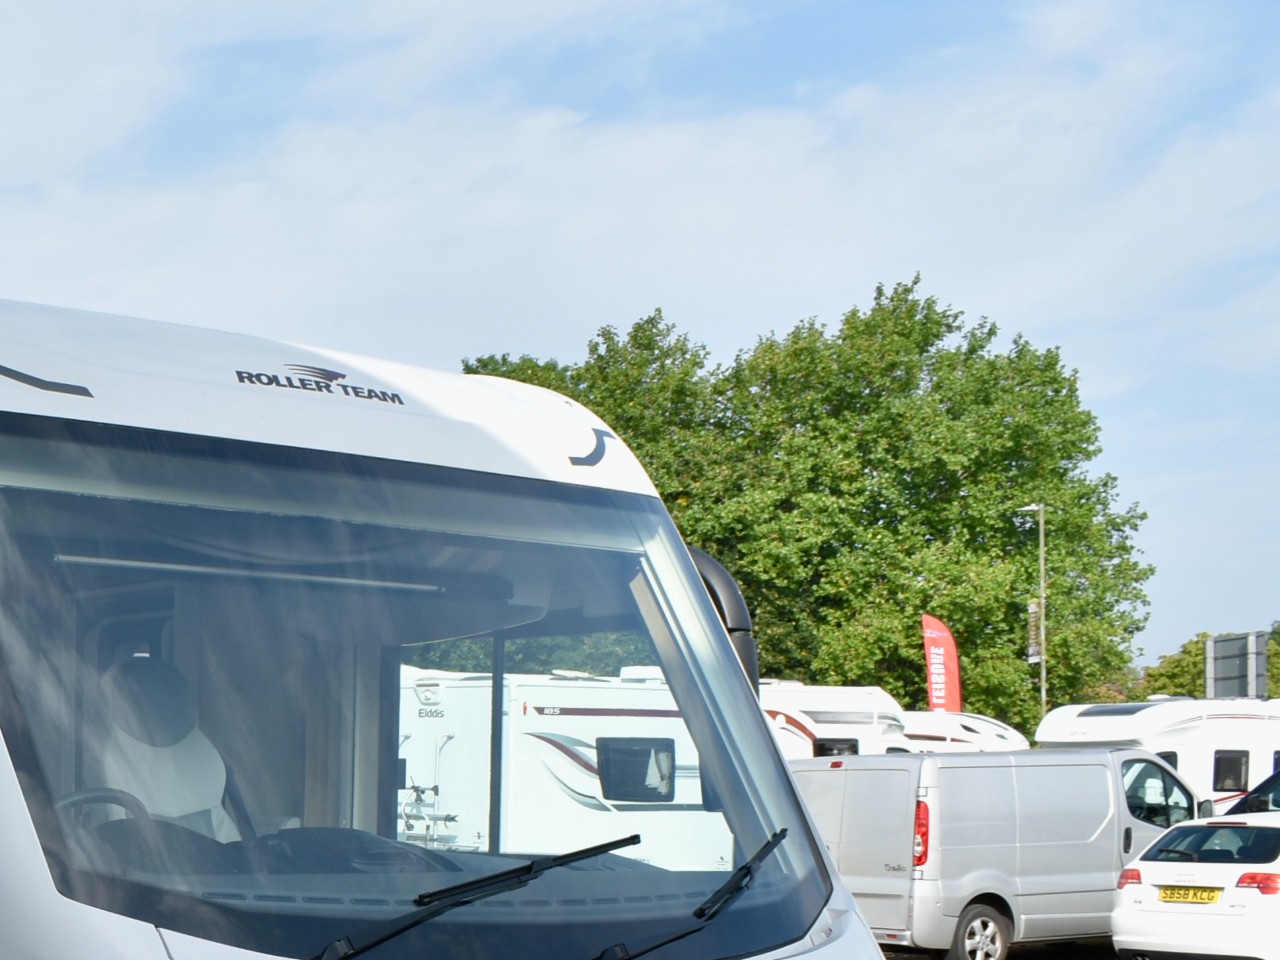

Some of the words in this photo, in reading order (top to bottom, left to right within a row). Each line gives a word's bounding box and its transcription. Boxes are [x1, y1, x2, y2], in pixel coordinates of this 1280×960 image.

[235, 370, 334, 394] ROLLER
[337, 383, 405, 406] TEAM
[418, 708, 445, 718] Elddis
[1161, 887, 1190, 900] SB58
[1191, 888, 1215, 902] KCG
